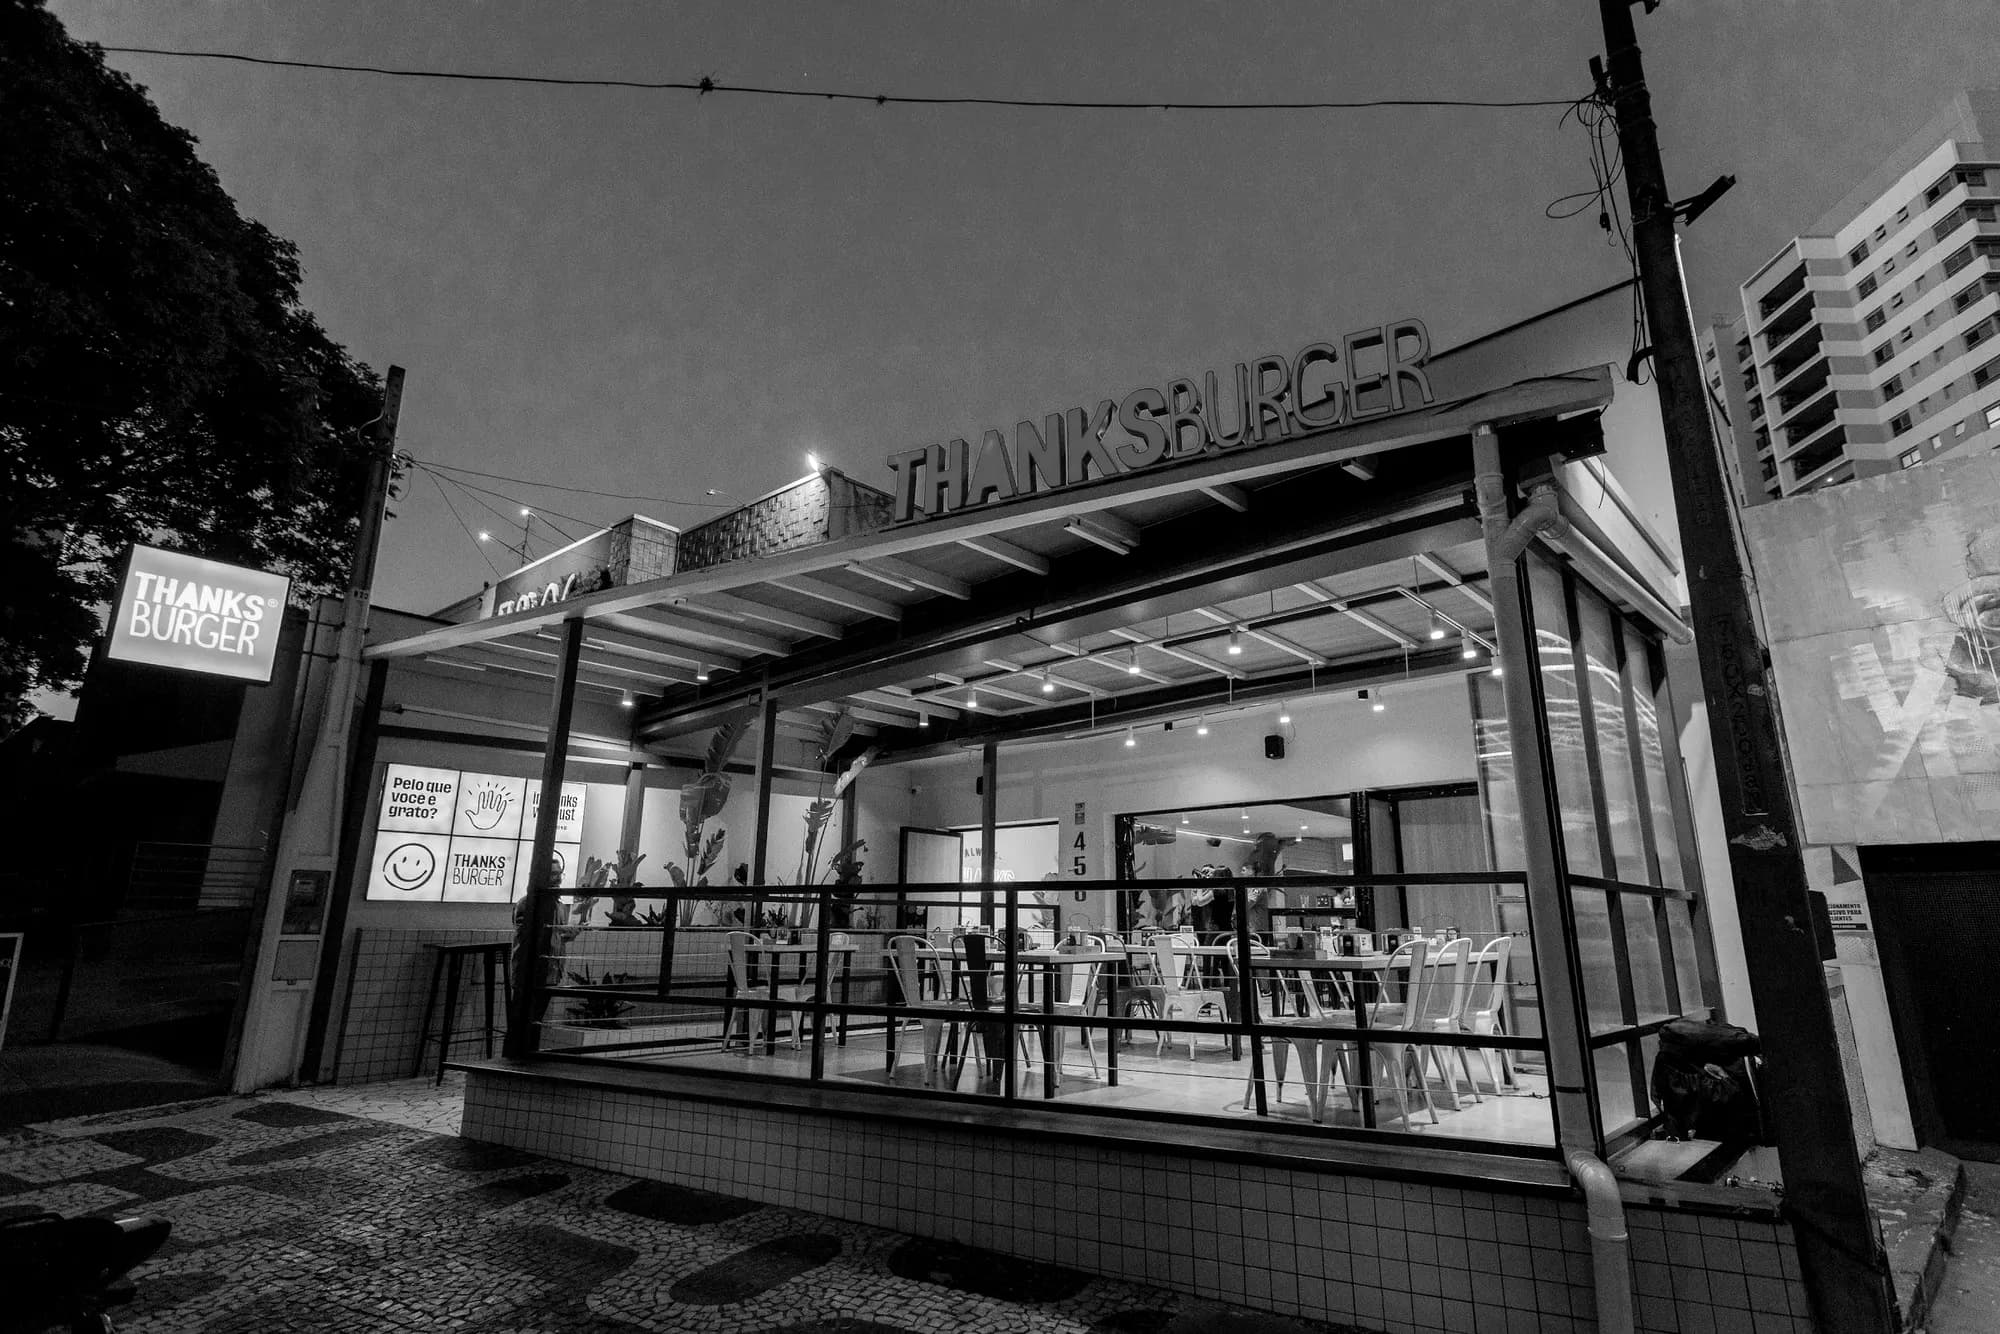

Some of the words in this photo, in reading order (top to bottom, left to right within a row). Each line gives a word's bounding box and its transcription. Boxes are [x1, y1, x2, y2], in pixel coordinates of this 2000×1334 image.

[134, 571, 265, 621] THANKS
[129, 600, 260, 656] BURGER
[393, 777, 424, 791] Pelo
[426, 781, 451, 794] que
[560, 794, 578, 807] nks
[388, 806, 438, 819] grato?
[559, 808, 575, 821] ust
[454, 854, 506, 869] THANKS
[452, 868, 505, 886] BURGER
